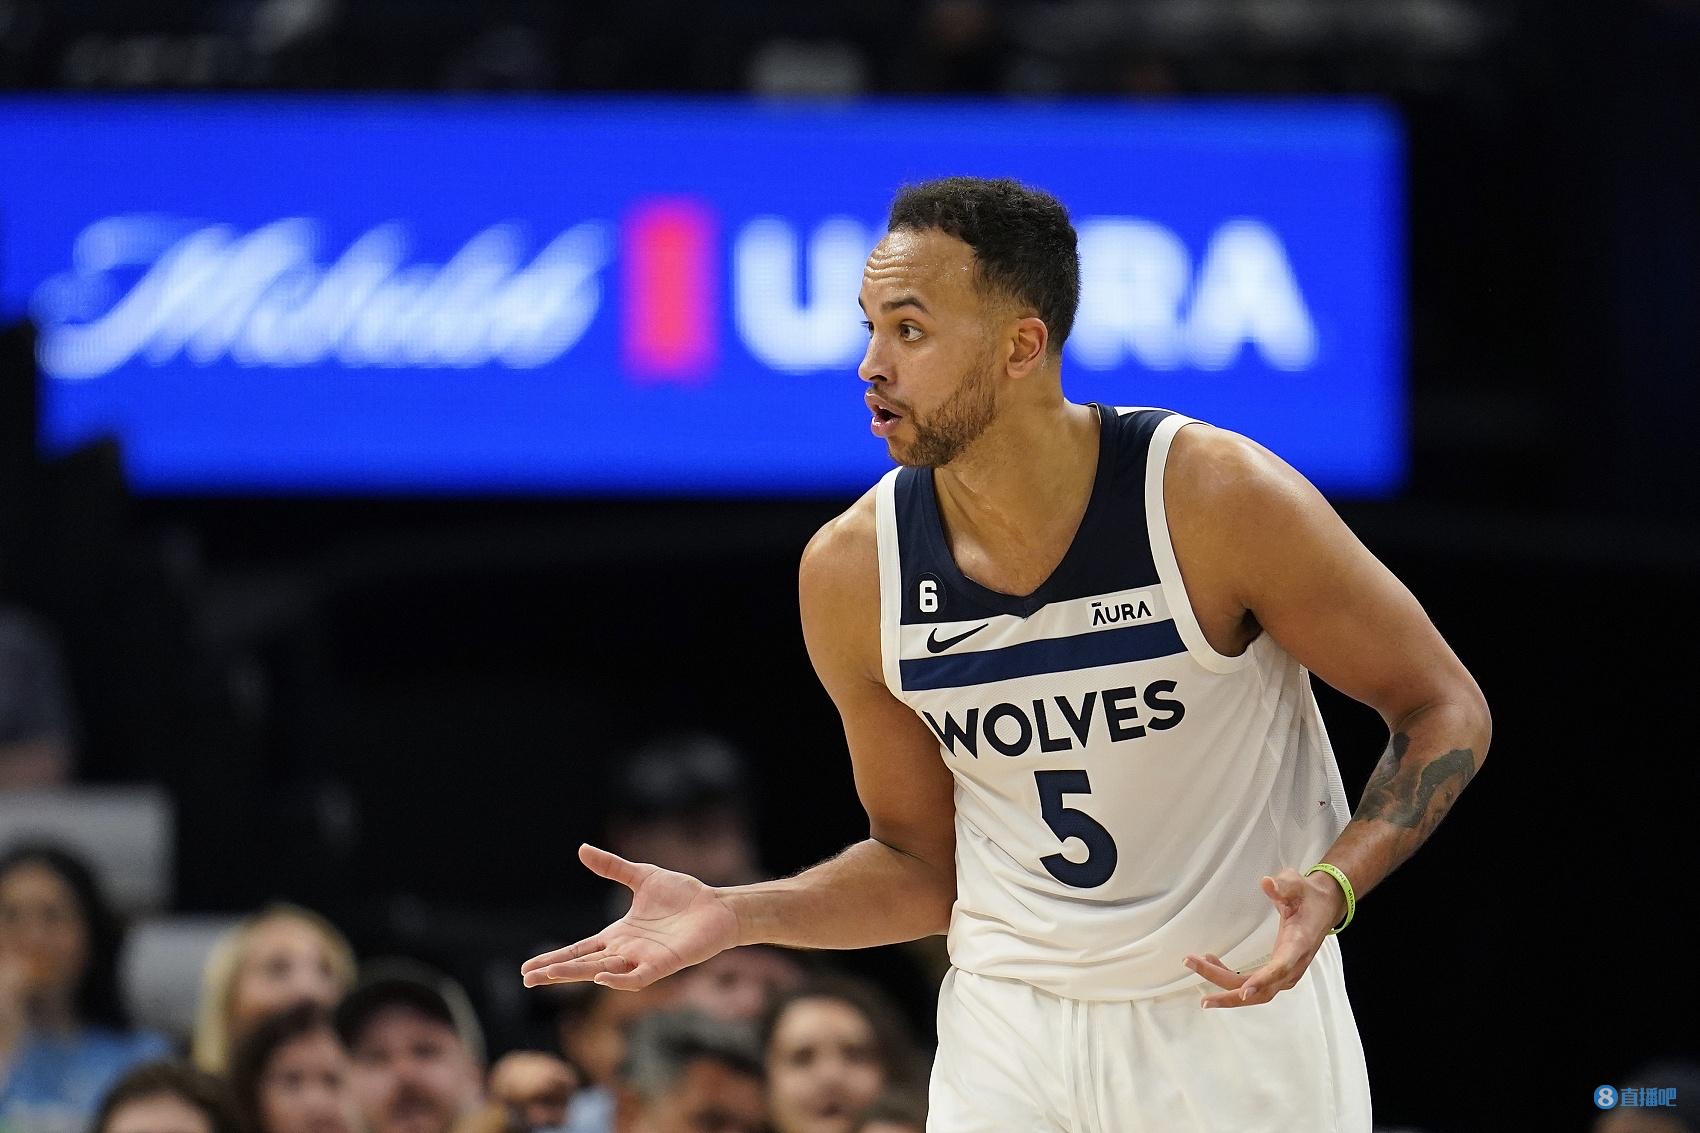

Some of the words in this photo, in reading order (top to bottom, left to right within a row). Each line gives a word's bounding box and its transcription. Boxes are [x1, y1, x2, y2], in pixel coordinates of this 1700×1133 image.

[919, 580, 939, 613] 6
[922, 679, 1186, 759] WOLVES
[1033, 769, 1118, 889] 5
